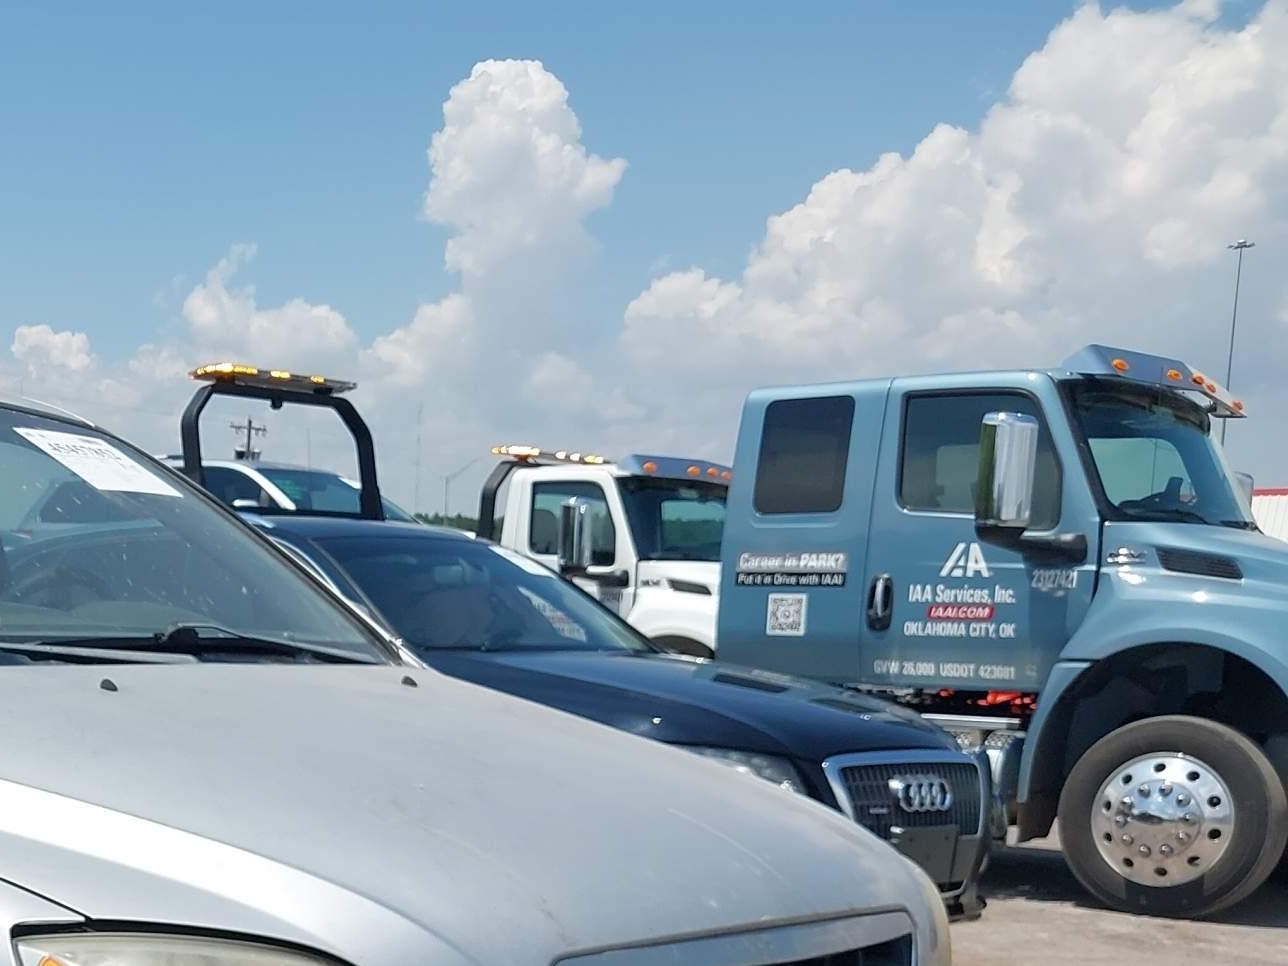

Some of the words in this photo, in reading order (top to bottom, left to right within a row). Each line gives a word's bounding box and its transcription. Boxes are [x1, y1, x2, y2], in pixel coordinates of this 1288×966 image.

[799, 553, 844, 569] PARK?
[908, 584, 932, 602] IAA
[935, 585, 992, 604] Services,
[994, 584, 1016, 603] Inc.
[903, 621, 966, 636] OKLAHOMA
[969, 622, 997, 638] CITY,
[999, 624, 1016, 638] OK
[873, 659, 900, 674] GVW
[939, 663, 975, 678] USDOT
